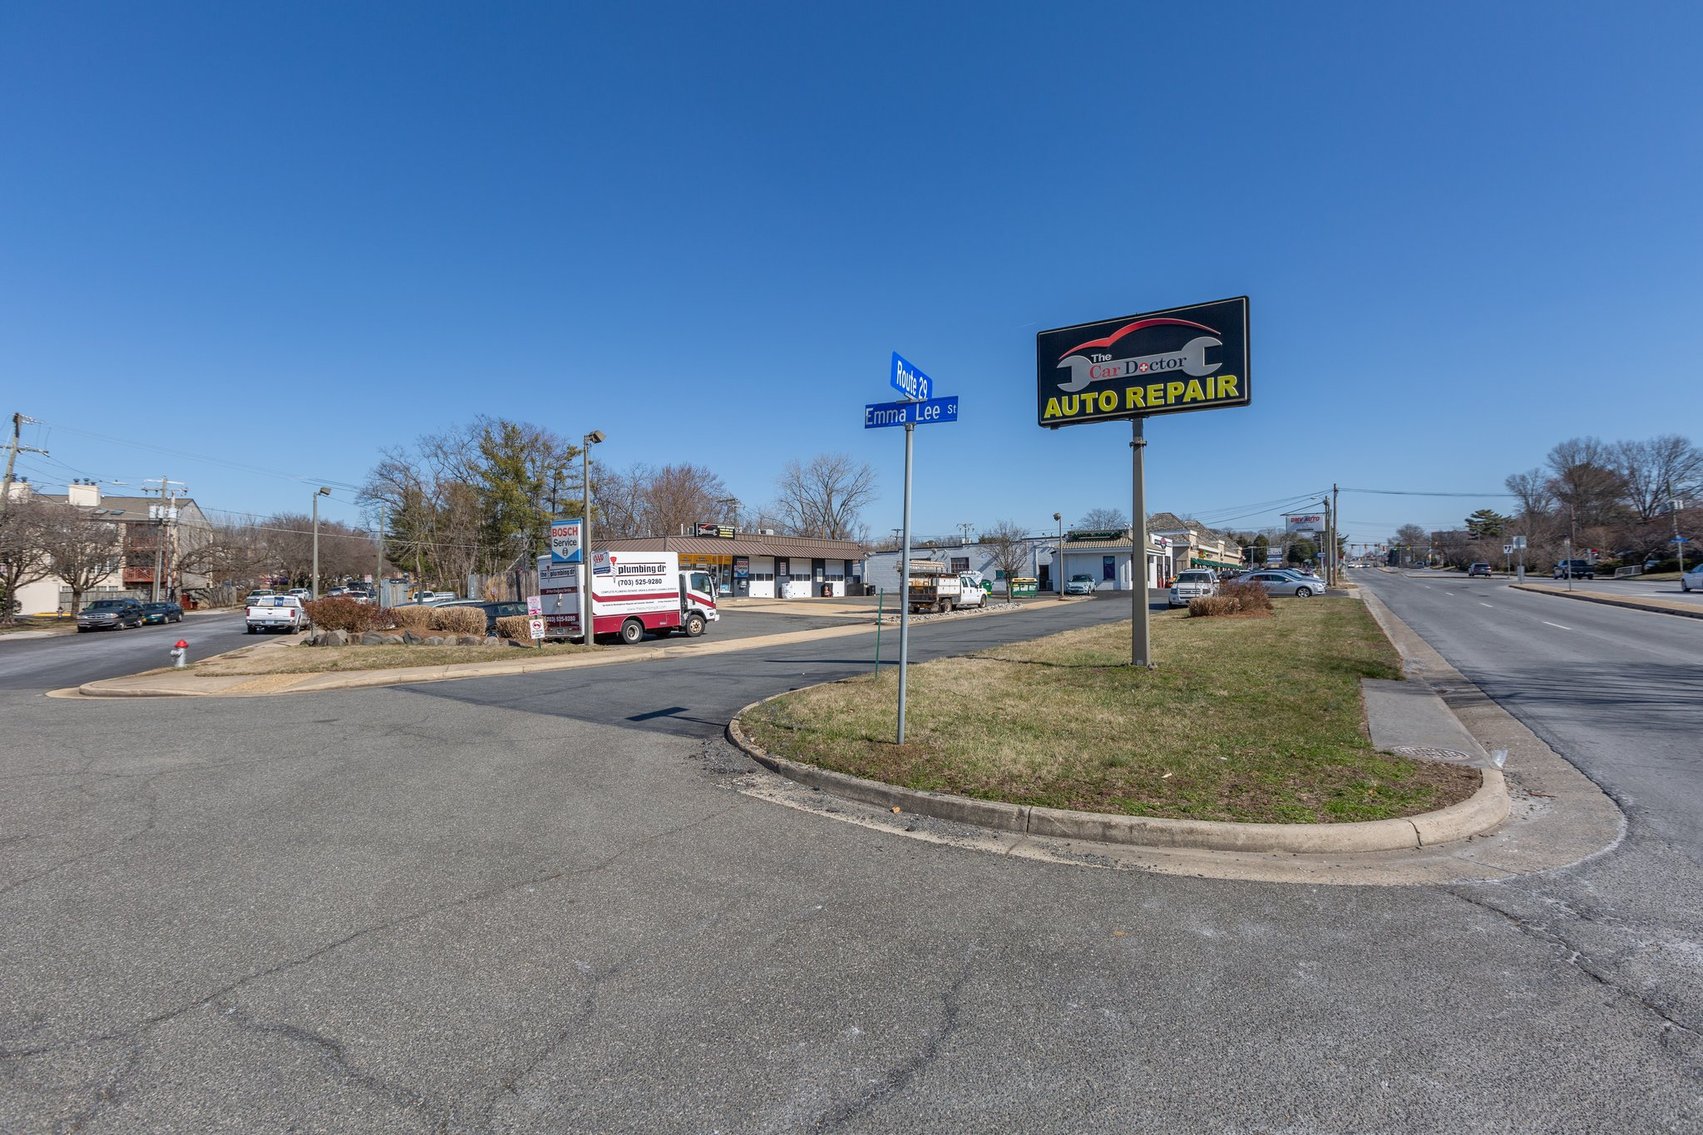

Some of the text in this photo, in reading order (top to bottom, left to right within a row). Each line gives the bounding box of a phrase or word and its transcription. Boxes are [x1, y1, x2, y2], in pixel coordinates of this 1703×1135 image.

[1091, 353, 1112, 363] The
[1089, 355, 1187, 379] Car Doctor
[896, 360, 928, 399] Route 29
[1043, 374, 1239, 419] AUTO REPAIR
[865, 403, 957, 425] Emma Lee St
[552, 526, 578, 537] BOSCH
[553, 538, 577, 547] Service
[617, 565, 656, 575] plumbing
[657, 564, 667, 573] dr
[617, 578, 663, 587] (703) 525-9280
